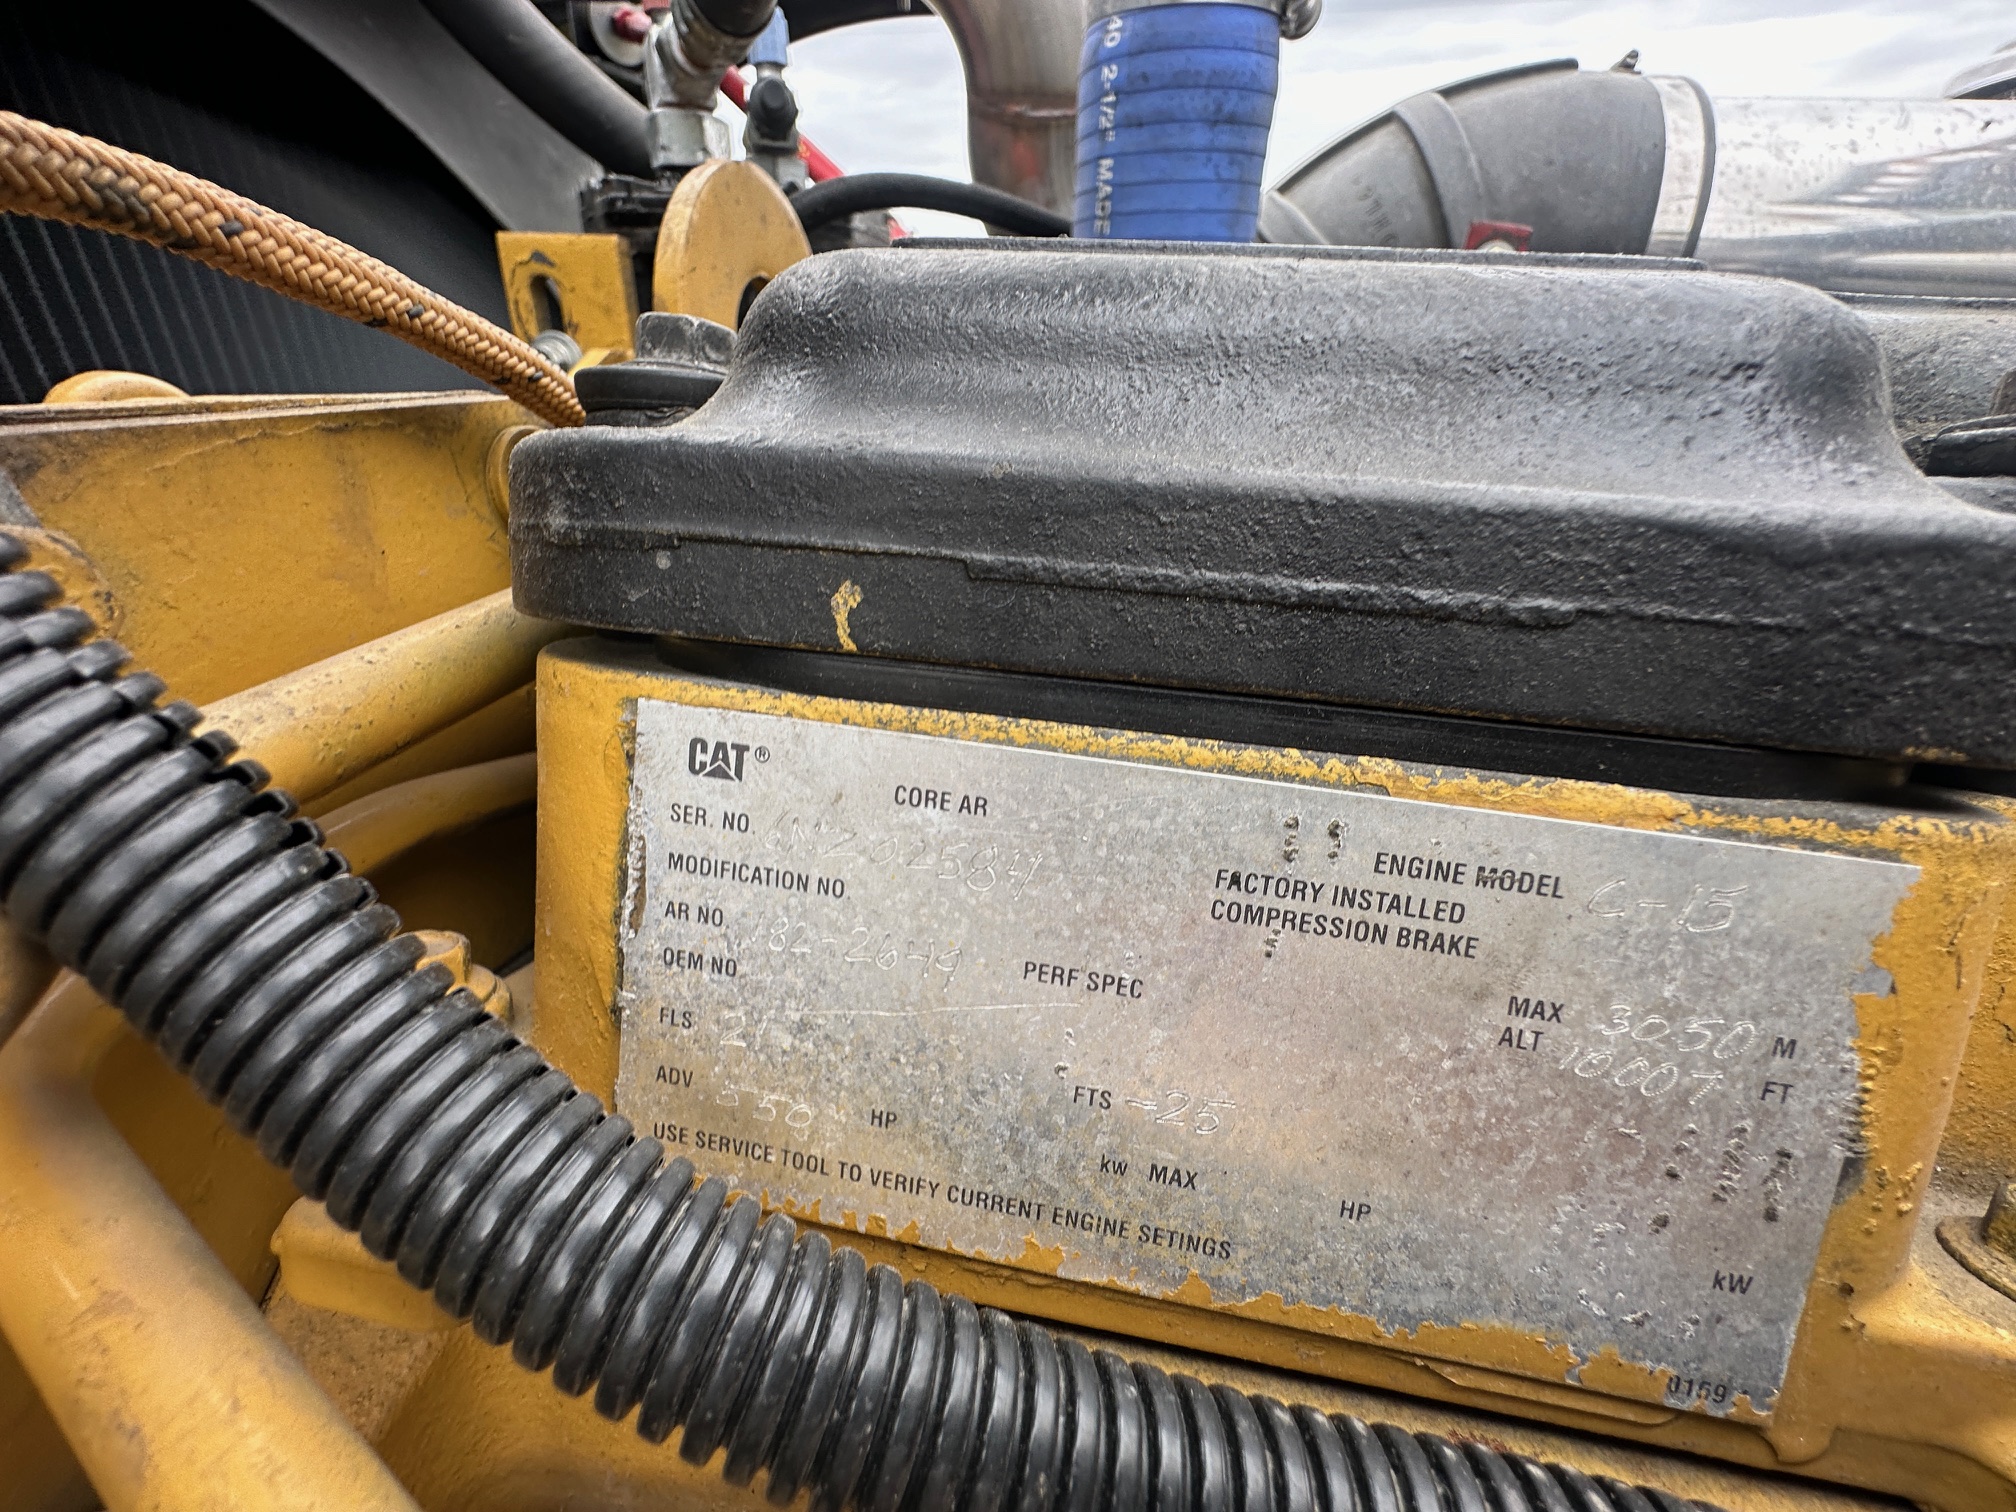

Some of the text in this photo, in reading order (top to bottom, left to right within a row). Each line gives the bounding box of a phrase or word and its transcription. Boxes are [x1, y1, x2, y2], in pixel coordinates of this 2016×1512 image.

[1093, 158, 1115, 236] MADE
[670, 803, 714, 828] SER.
[722, 810, 756, 835] NO.
[893, 785, 990, 818] CORE AR
[668, 852, 809, 893] MODIFICATION
[1373, 852, 1749, 933] ENGINE MODEL C-15
[665, 900, 689, 921] AR
[1215, 869, 1466, 924] FACTORY INSTALLED
[1210, 900, 1480, 960] COMPRESSION BRAKE
[663, 946, 704, 973] OEM
[1023, 961, 1144, 1000] PERF SPEC
[659, 1006, 693, 1030] FLS
[1507, 996, 1565, 1024] MAX
[1772, 1037, 1798, 1060] M
[1498, 1027, 1545, 1052] ALT
[1761, 1081, 1794, 1105] FT
[656, 1065, 694, 1088] ADV
[869, 1108, 898, 1130] HP
[1073, 1085, 1112, 1111] FTS
[653, 1121, 1233, 1260] USE SERVICE TOOL TO VERIFY CURRENT ENGINE SETINGS
[1149, 1163, 1198, 1191] MAX
[1339, 1201, 1372, 1222] HP
